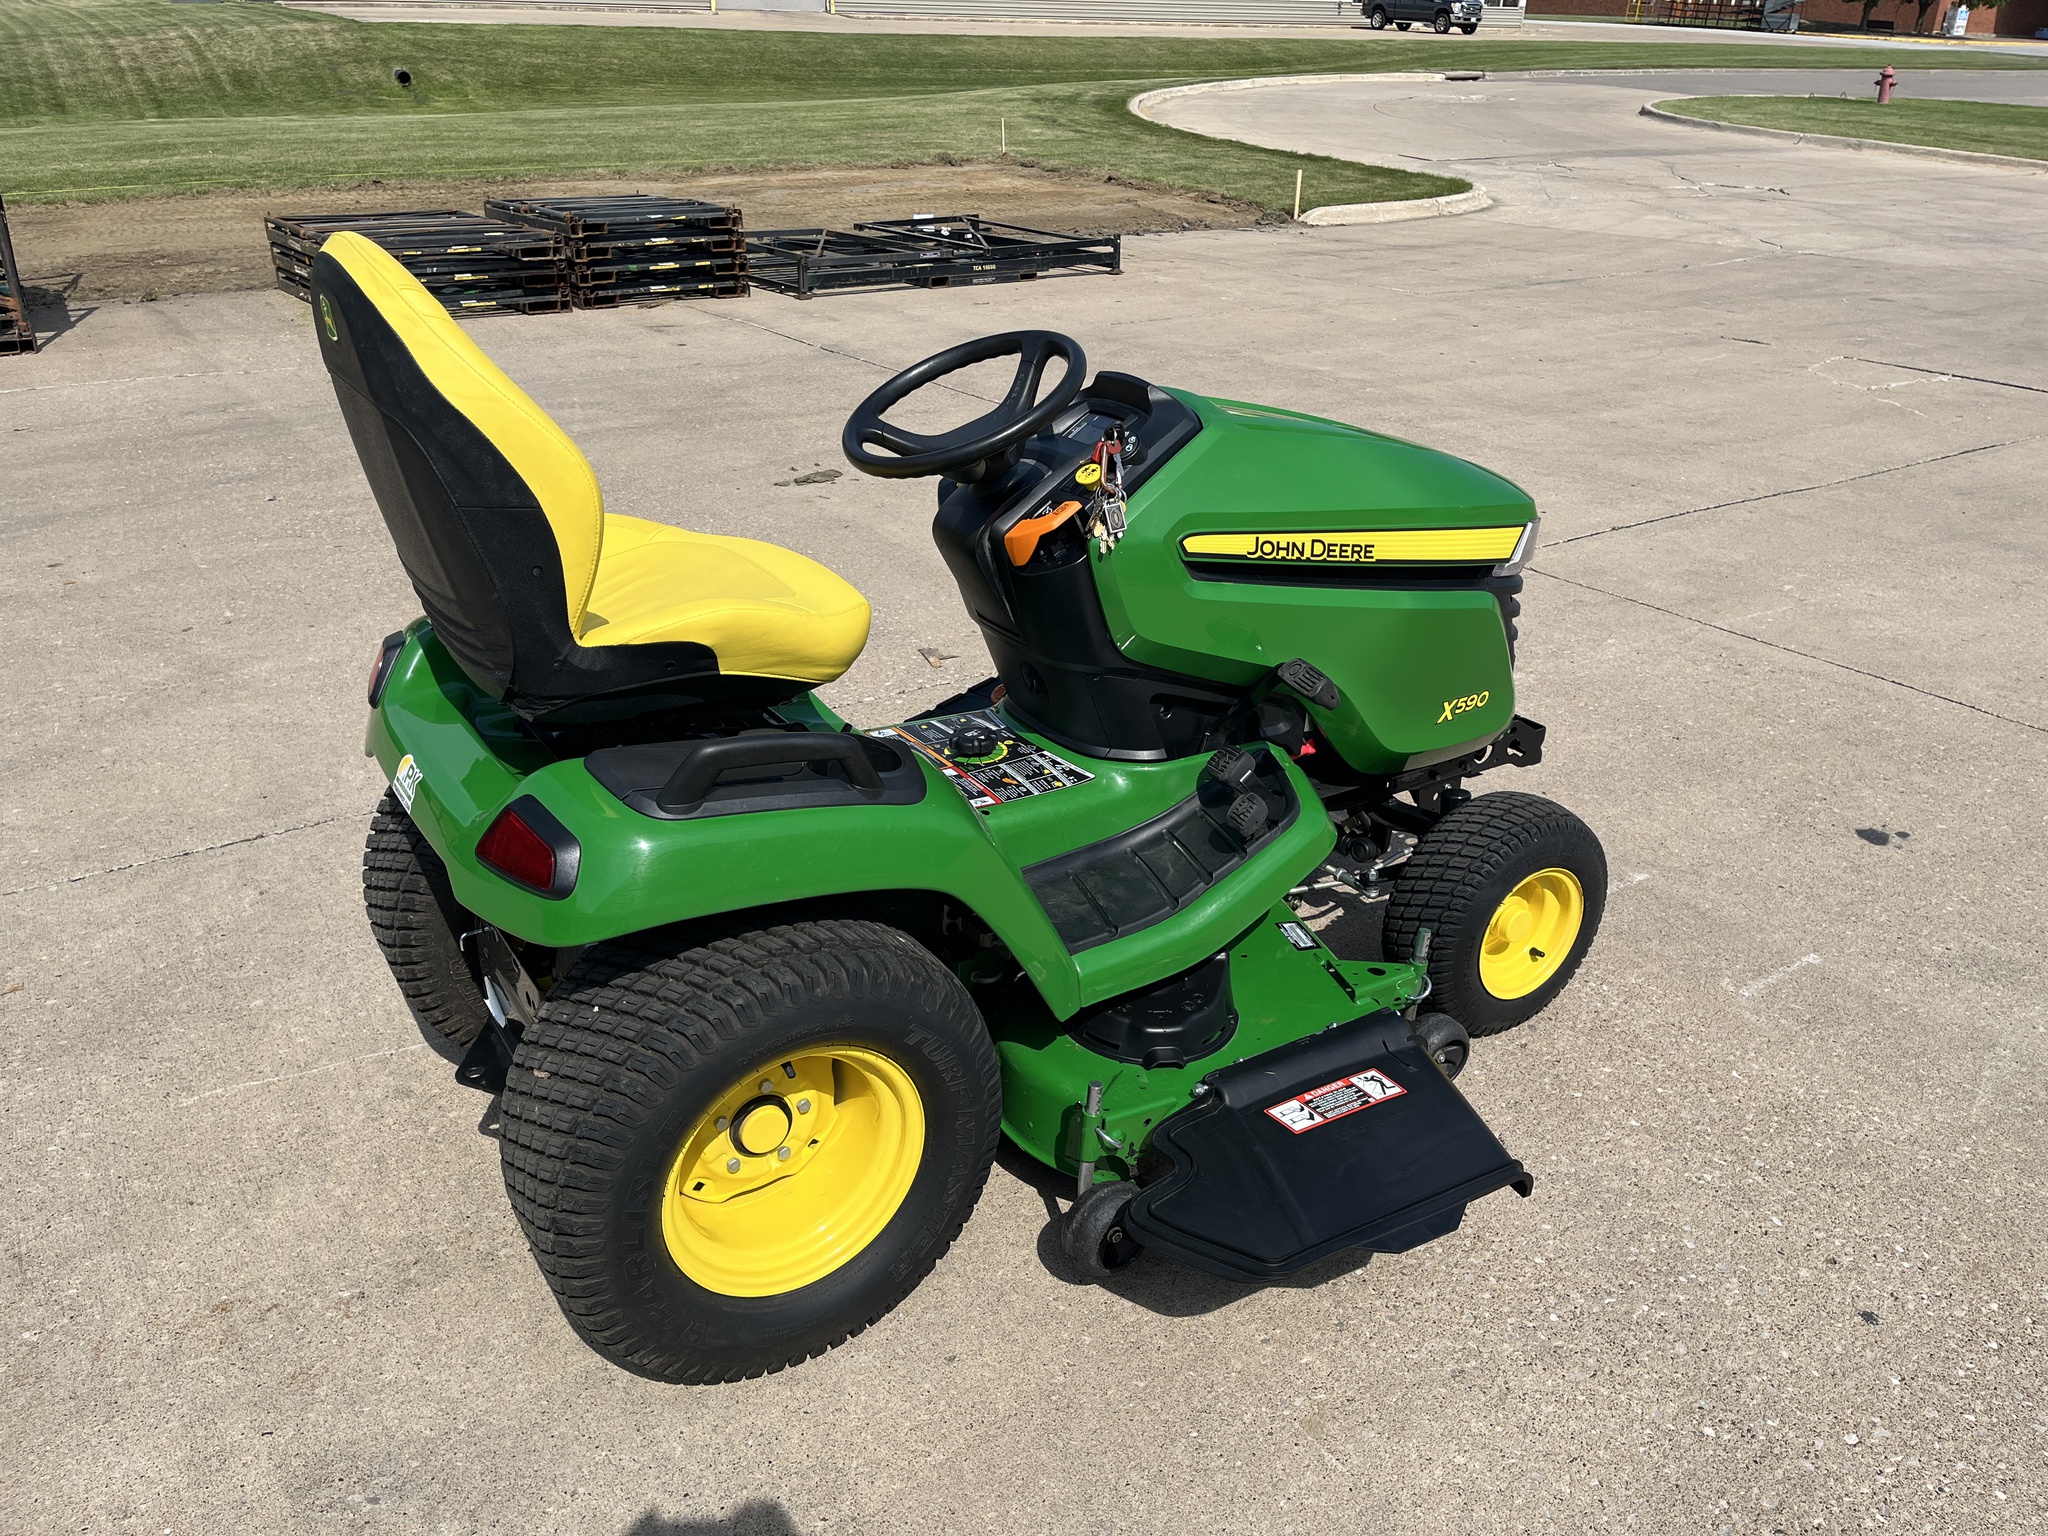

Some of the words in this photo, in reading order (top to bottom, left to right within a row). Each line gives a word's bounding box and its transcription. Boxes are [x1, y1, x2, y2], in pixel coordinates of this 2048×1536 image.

[1246, 535, 1306, 559] JOHN
[1309, 538, 1376, 562] DEERE
[1434, 690, 1490, 725] X590
[904, 1021, 975, 1101] TURF
[1311, 1081, 1347, 1098] DANGER
[622, 1109, 687, 1331] CARLISLE
[886, 1109, 976, 1284] MASTER
